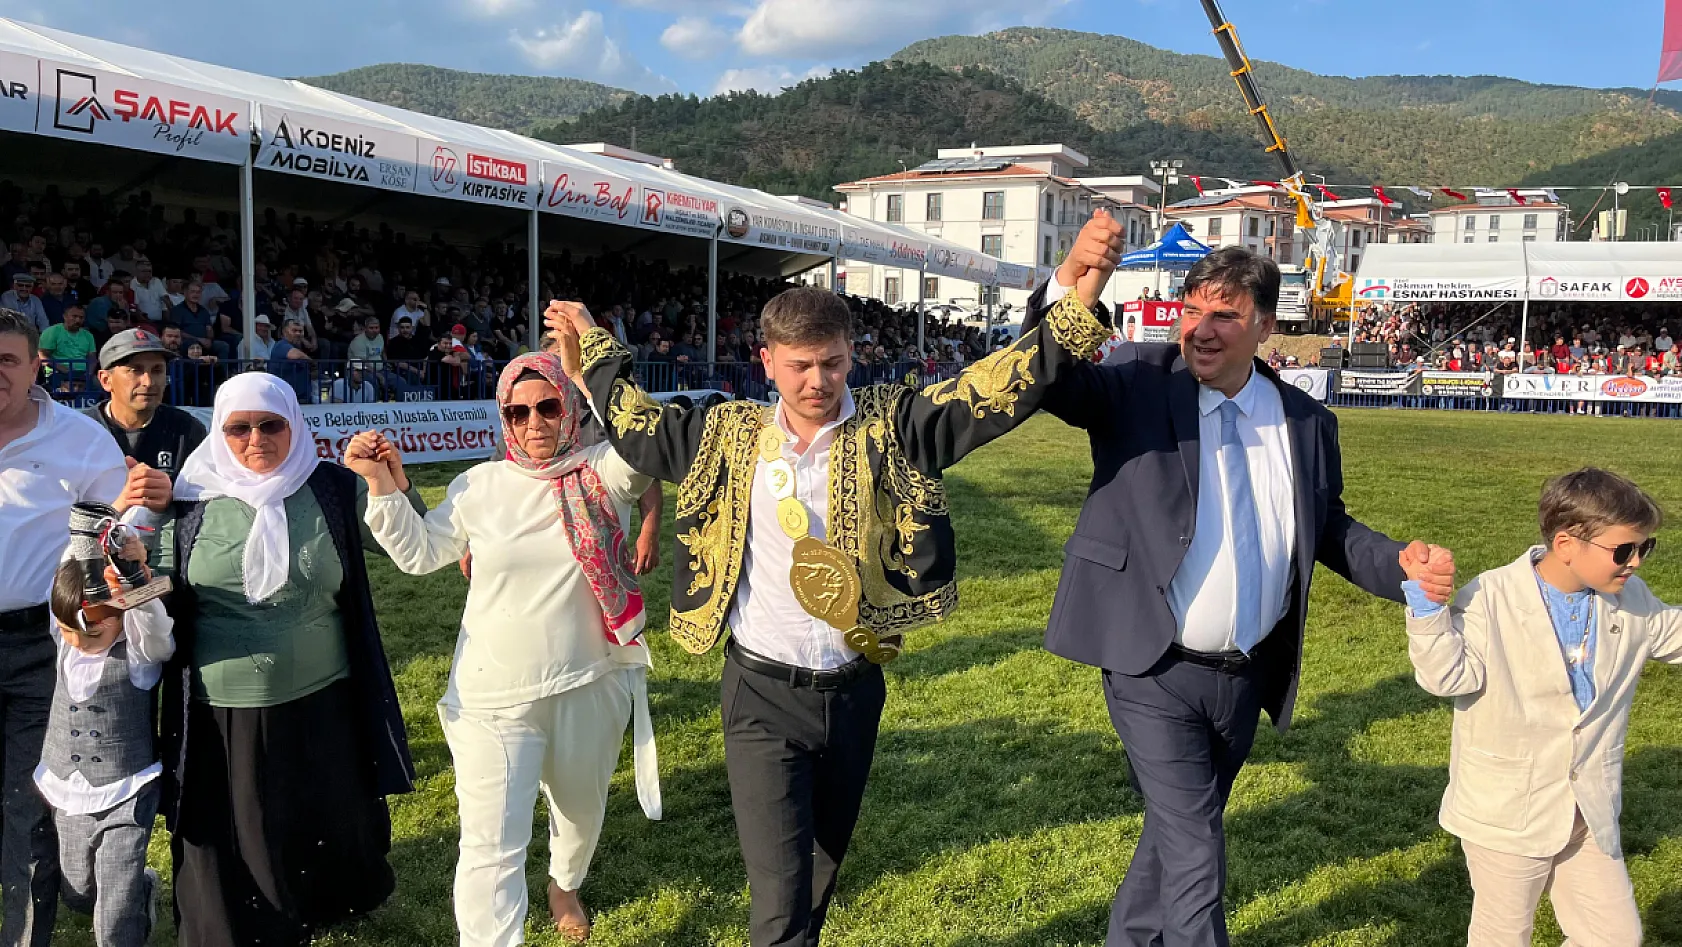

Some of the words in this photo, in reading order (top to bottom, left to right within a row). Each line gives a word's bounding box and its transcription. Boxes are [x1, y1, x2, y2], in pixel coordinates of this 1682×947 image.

[113, 89, 239, 137] ŞAFAK
[153, 122, 204, 151] Profil
[270, 113, 376, 159] AKDENİZ
[270, 151, 370, 182] MOBİLYA
[469, 152, 526, 183] İSTİKBAL
[462, 181, 527, 203] KIRTASİYE
[593, 181, 633, 219] Bal
[1392, 289, 1438, 299] ESNAF
[1439, 289, 1518, 299] HASTANESİ
[1156, 306, 1184, 322] BA
[1507, 375, 1589, 392] ÖNVER
[324, 410, 389, 428] Belediyesi
[392, 409, 439, 424] Mustafa
